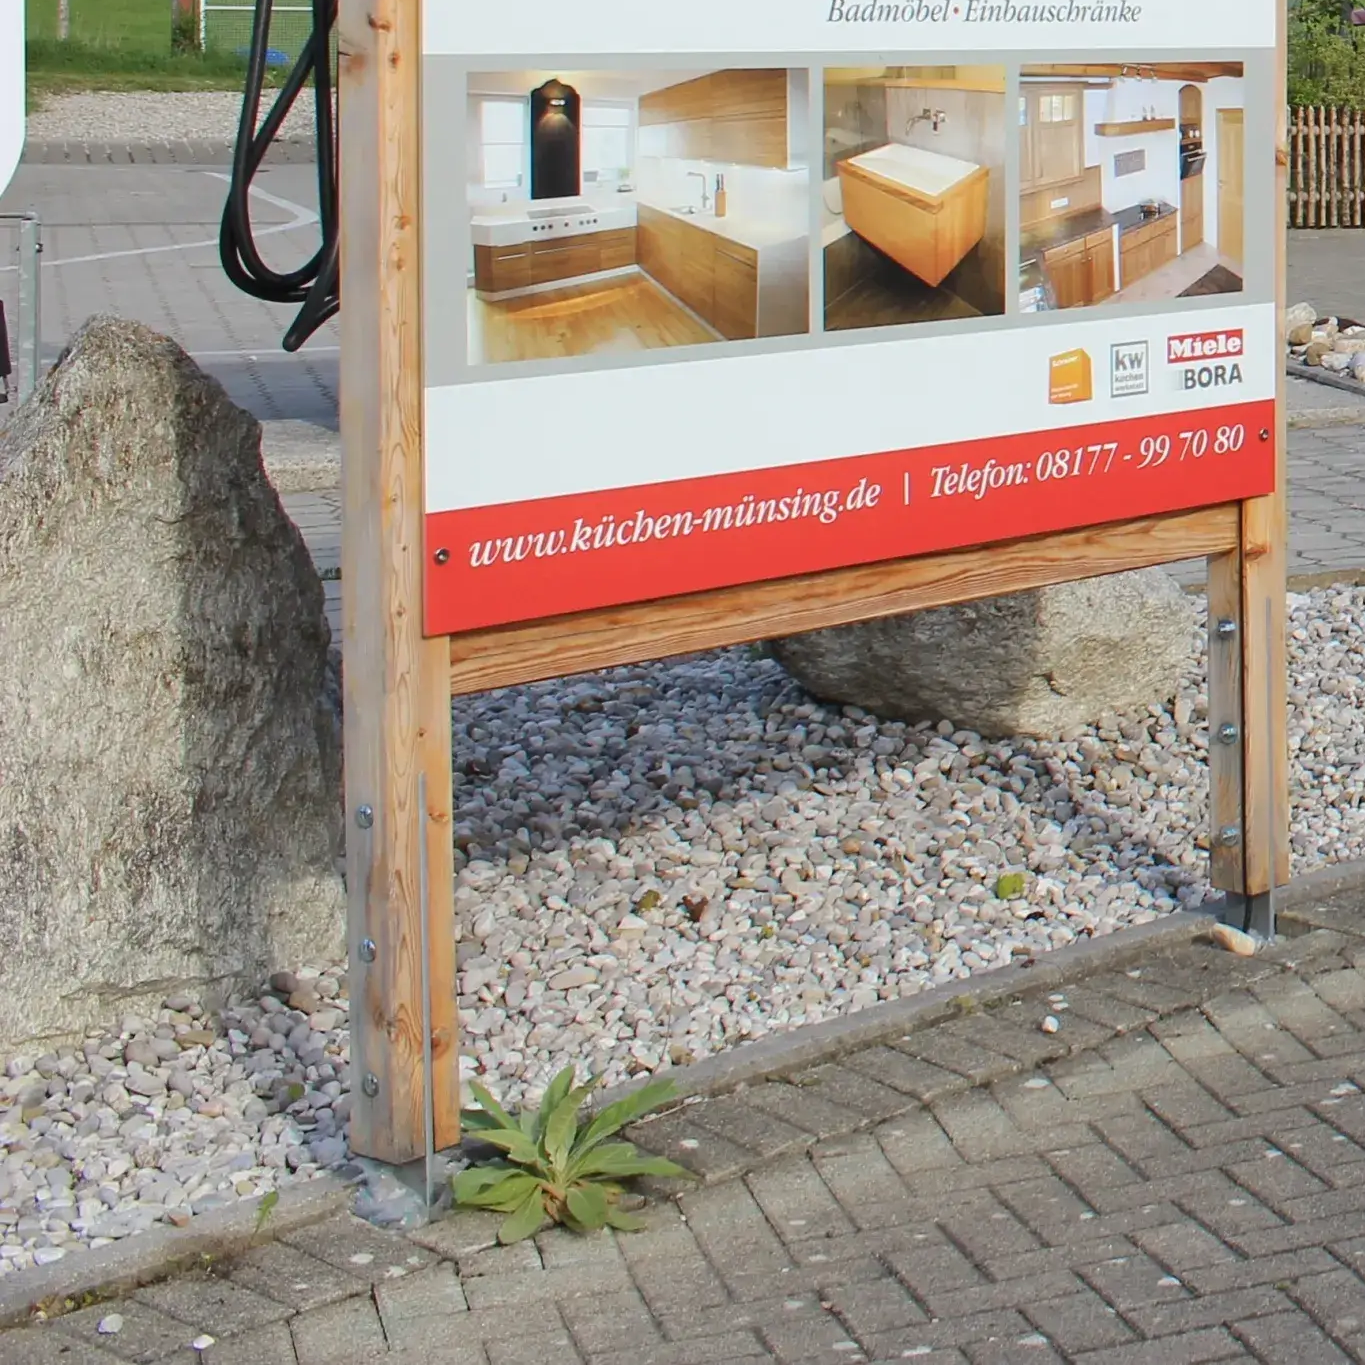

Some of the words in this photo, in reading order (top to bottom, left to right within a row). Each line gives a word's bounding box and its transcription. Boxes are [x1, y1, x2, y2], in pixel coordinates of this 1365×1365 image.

[1114, 348, 1145, 372] kw
[1169, 334, 1241, 360] Miele
[1184, 363, 1243, 390] BORA
[469, 477, 881, 568] www.küchen-münsing.de
[930, 459, 1032, 500] Telefon:
[1036, 442, 1118, 482] 08177
[1137, 435, 1170, 469] 99
[1178, 429, 1207, 462] 70
[1214, 423, 1245, 454] 80
